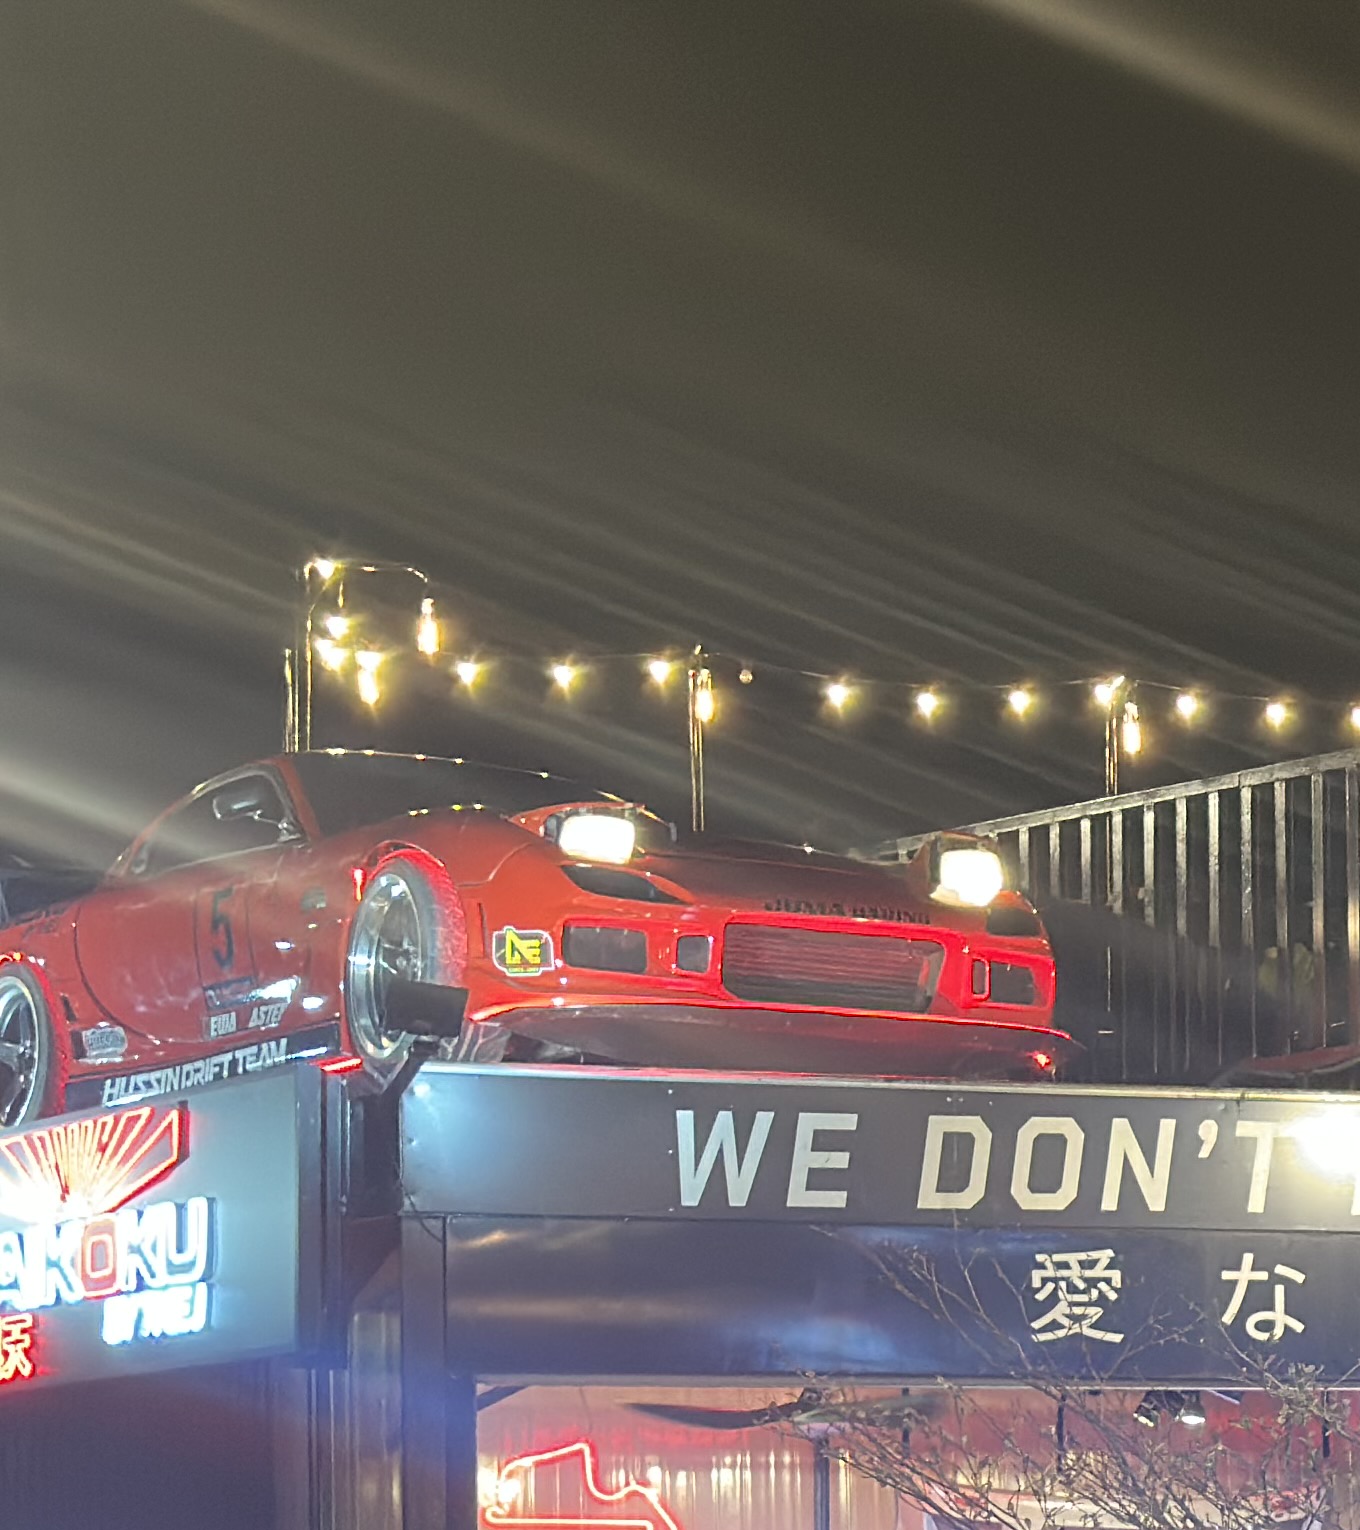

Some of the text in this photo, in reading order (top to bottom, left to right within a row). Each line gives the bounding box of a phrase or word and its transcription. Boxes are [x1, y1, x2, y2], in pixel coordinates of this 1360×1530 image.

[211, 888, 237, 970] 5
[102, 1038, 288, 1107] HUSSIN DRIFT TEAM
[676, 1110, 858, 1208] WE
[917, 1114, 1296, 1213] DON'T
